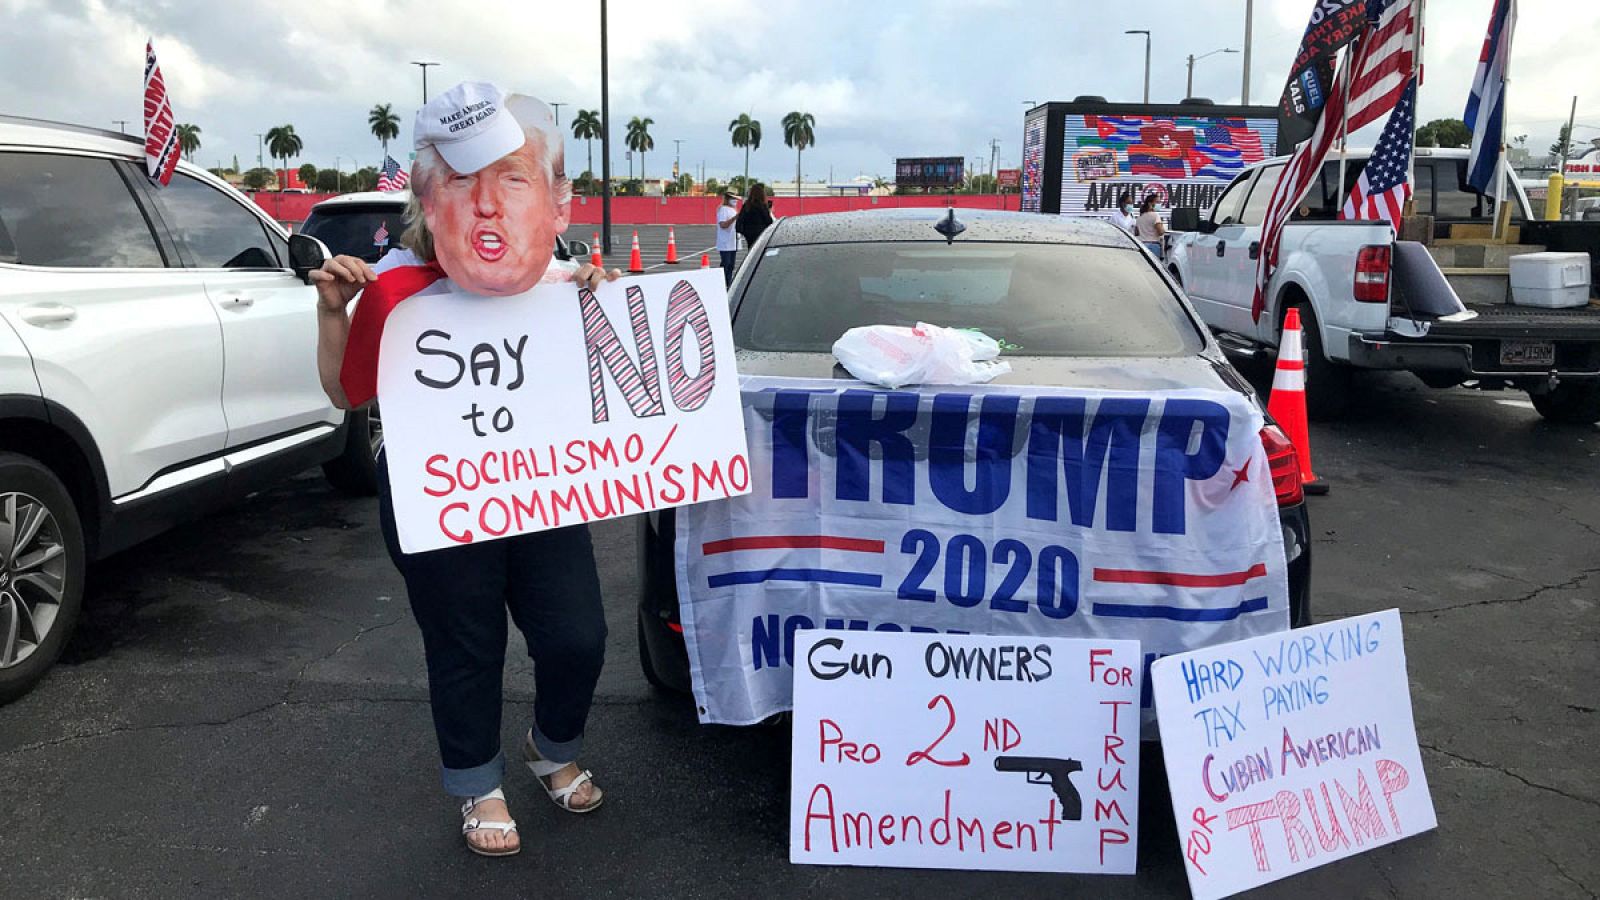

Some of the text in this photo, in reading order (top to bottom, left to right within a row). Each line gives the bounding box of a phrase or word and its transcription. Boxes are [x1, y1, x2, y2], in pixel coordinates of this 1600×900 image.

[440, 100, 492, 125] MAKE AMERICA
[448, 106, 496, 132] GREAT AGAIN
[1304, 66, 1321, 105] QUEL
[145, 94, 174, 158] NATI
[578, 279, 716, 424] NO
[462, 402, 515, 437] to
[439, 454, 749, 543] COMMUNISMO
[757, 388, 1230, 536] TRUMP
[897, 528, 1080, 620] 2020
[807, 637, 1053, 682] Gun OWNERS
[1181, 658, 1245, 704] HARD
[1254, 620, 1381, 679] WORKING
[1194, 675, 1330, 748] TAX PAYING
[1094, 701, 1133, 865] TRUMP
[1202, 724, 1382, 802] CUBAN AMERICAN
[804, 783, 1063, 853] Amendment
[1186, 759, 1410, 876] FOR TRUMP
